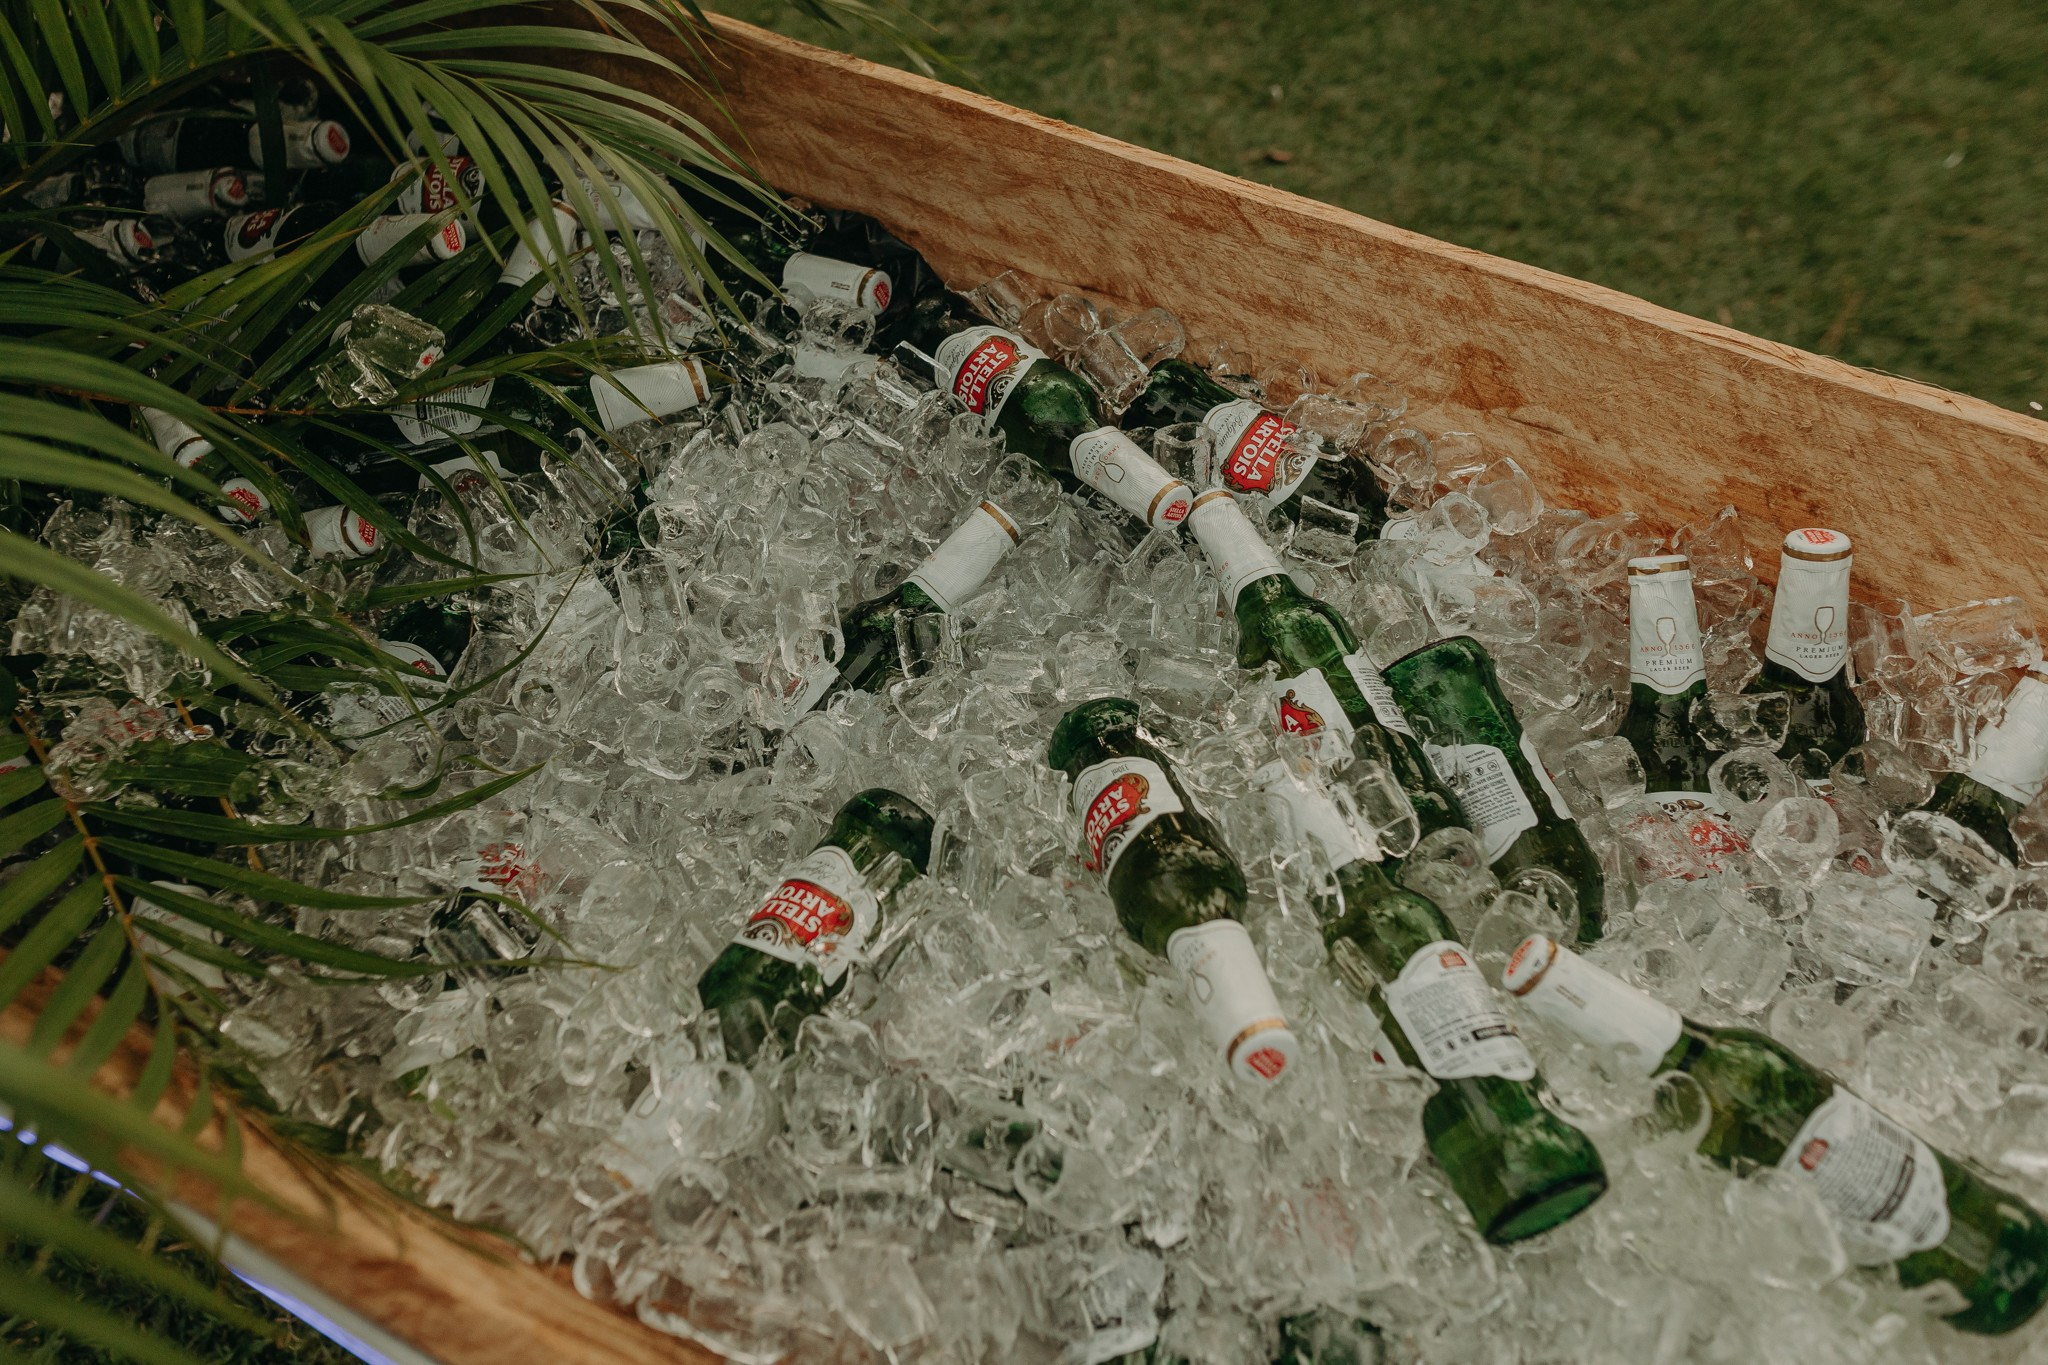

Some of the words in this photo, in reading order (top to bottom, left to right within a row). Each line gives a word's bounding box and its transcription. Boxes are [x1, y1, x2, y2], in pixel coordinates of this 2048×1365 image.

[958, 343, 998, 402] ARTOIS
[968, 351, 1009, 407] STELLA
[1219, 411, 1248, 447] Belgium
[1233, 417, 1280, 477] ARTOIS
[1085, 441, 1108, 475] PREMIUM
[1247, 427, 1294, 481] STELLA
[1790, 632, 1817, 640] ANNO
[1796, 645, 1844, 653] PREMIUM
[1645, 658, 1693, 666] PREMIUM
[1093, 797, 1130, 850] STELL
[760, 899, 822, 933] STELL
